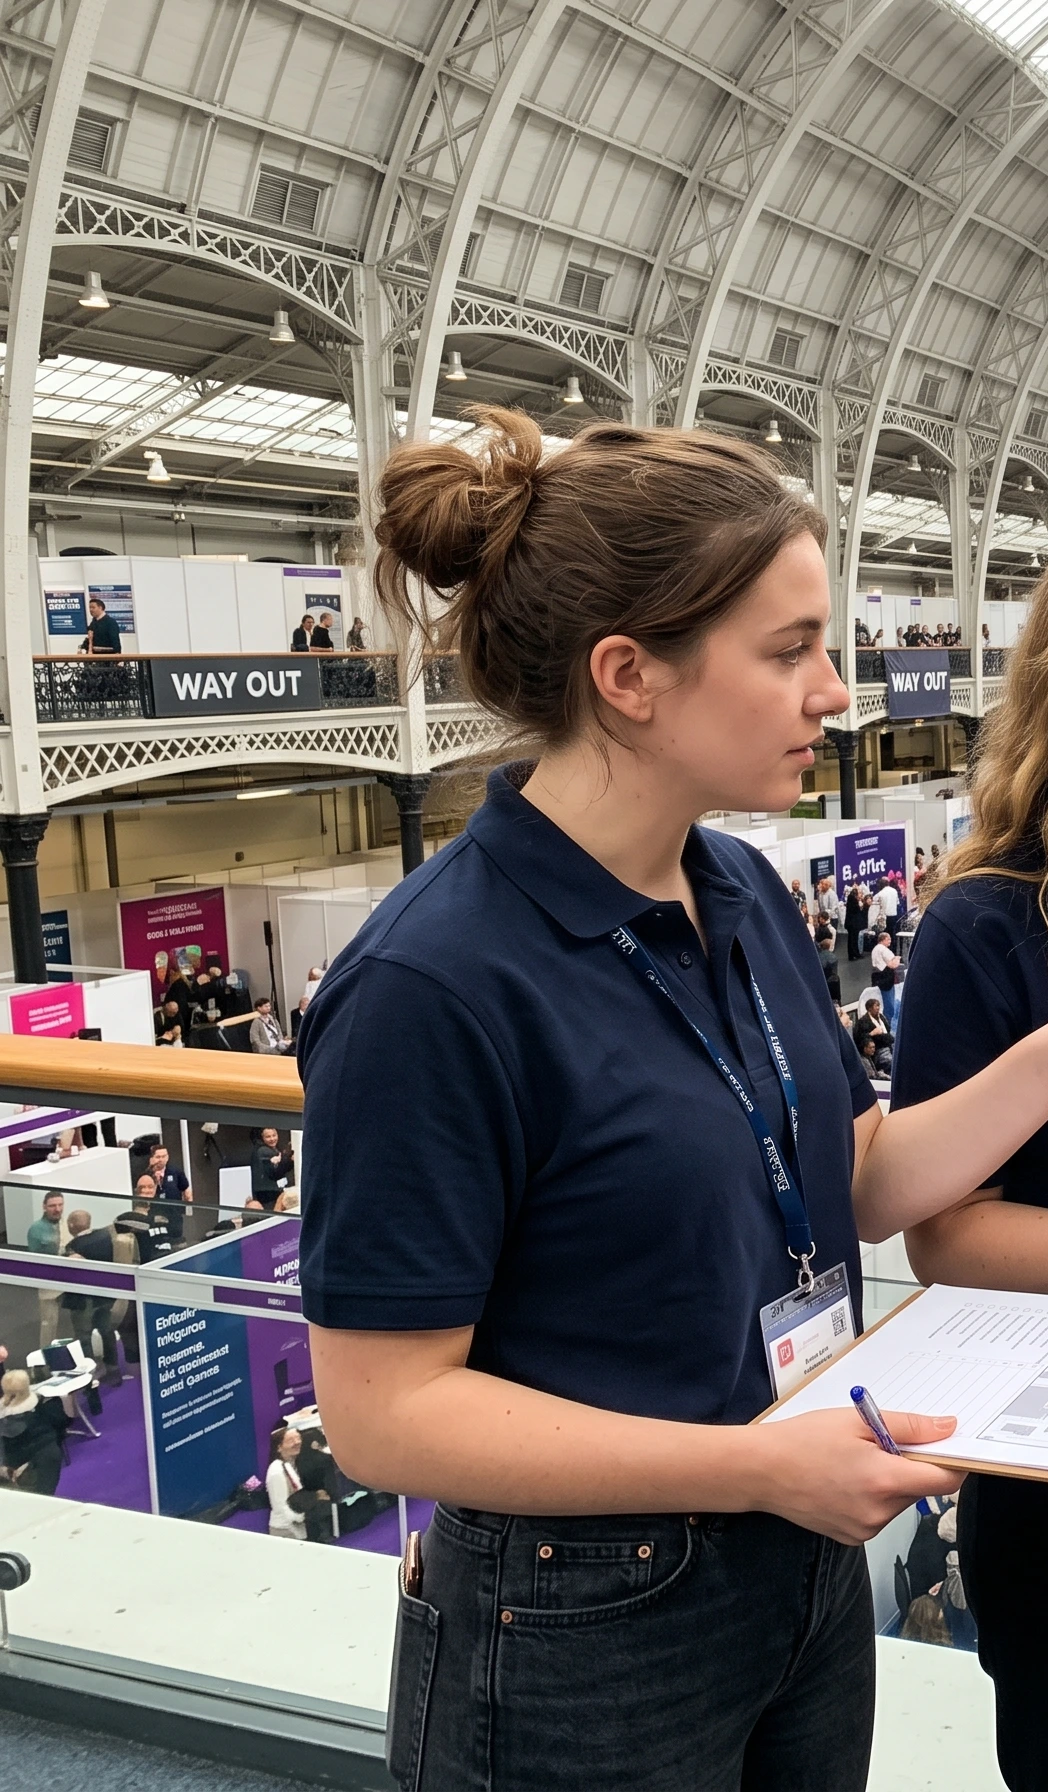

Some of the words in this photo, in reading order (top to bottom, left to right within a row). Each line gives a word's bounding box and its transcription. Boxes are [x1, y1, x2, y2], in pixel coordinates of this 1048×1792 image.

[170, 671, 238, 701] WAY
[246, 670, 302, 698] OUT
[890, 672, 920, 692] WAY
[923, 671, 948, 691] OUT
